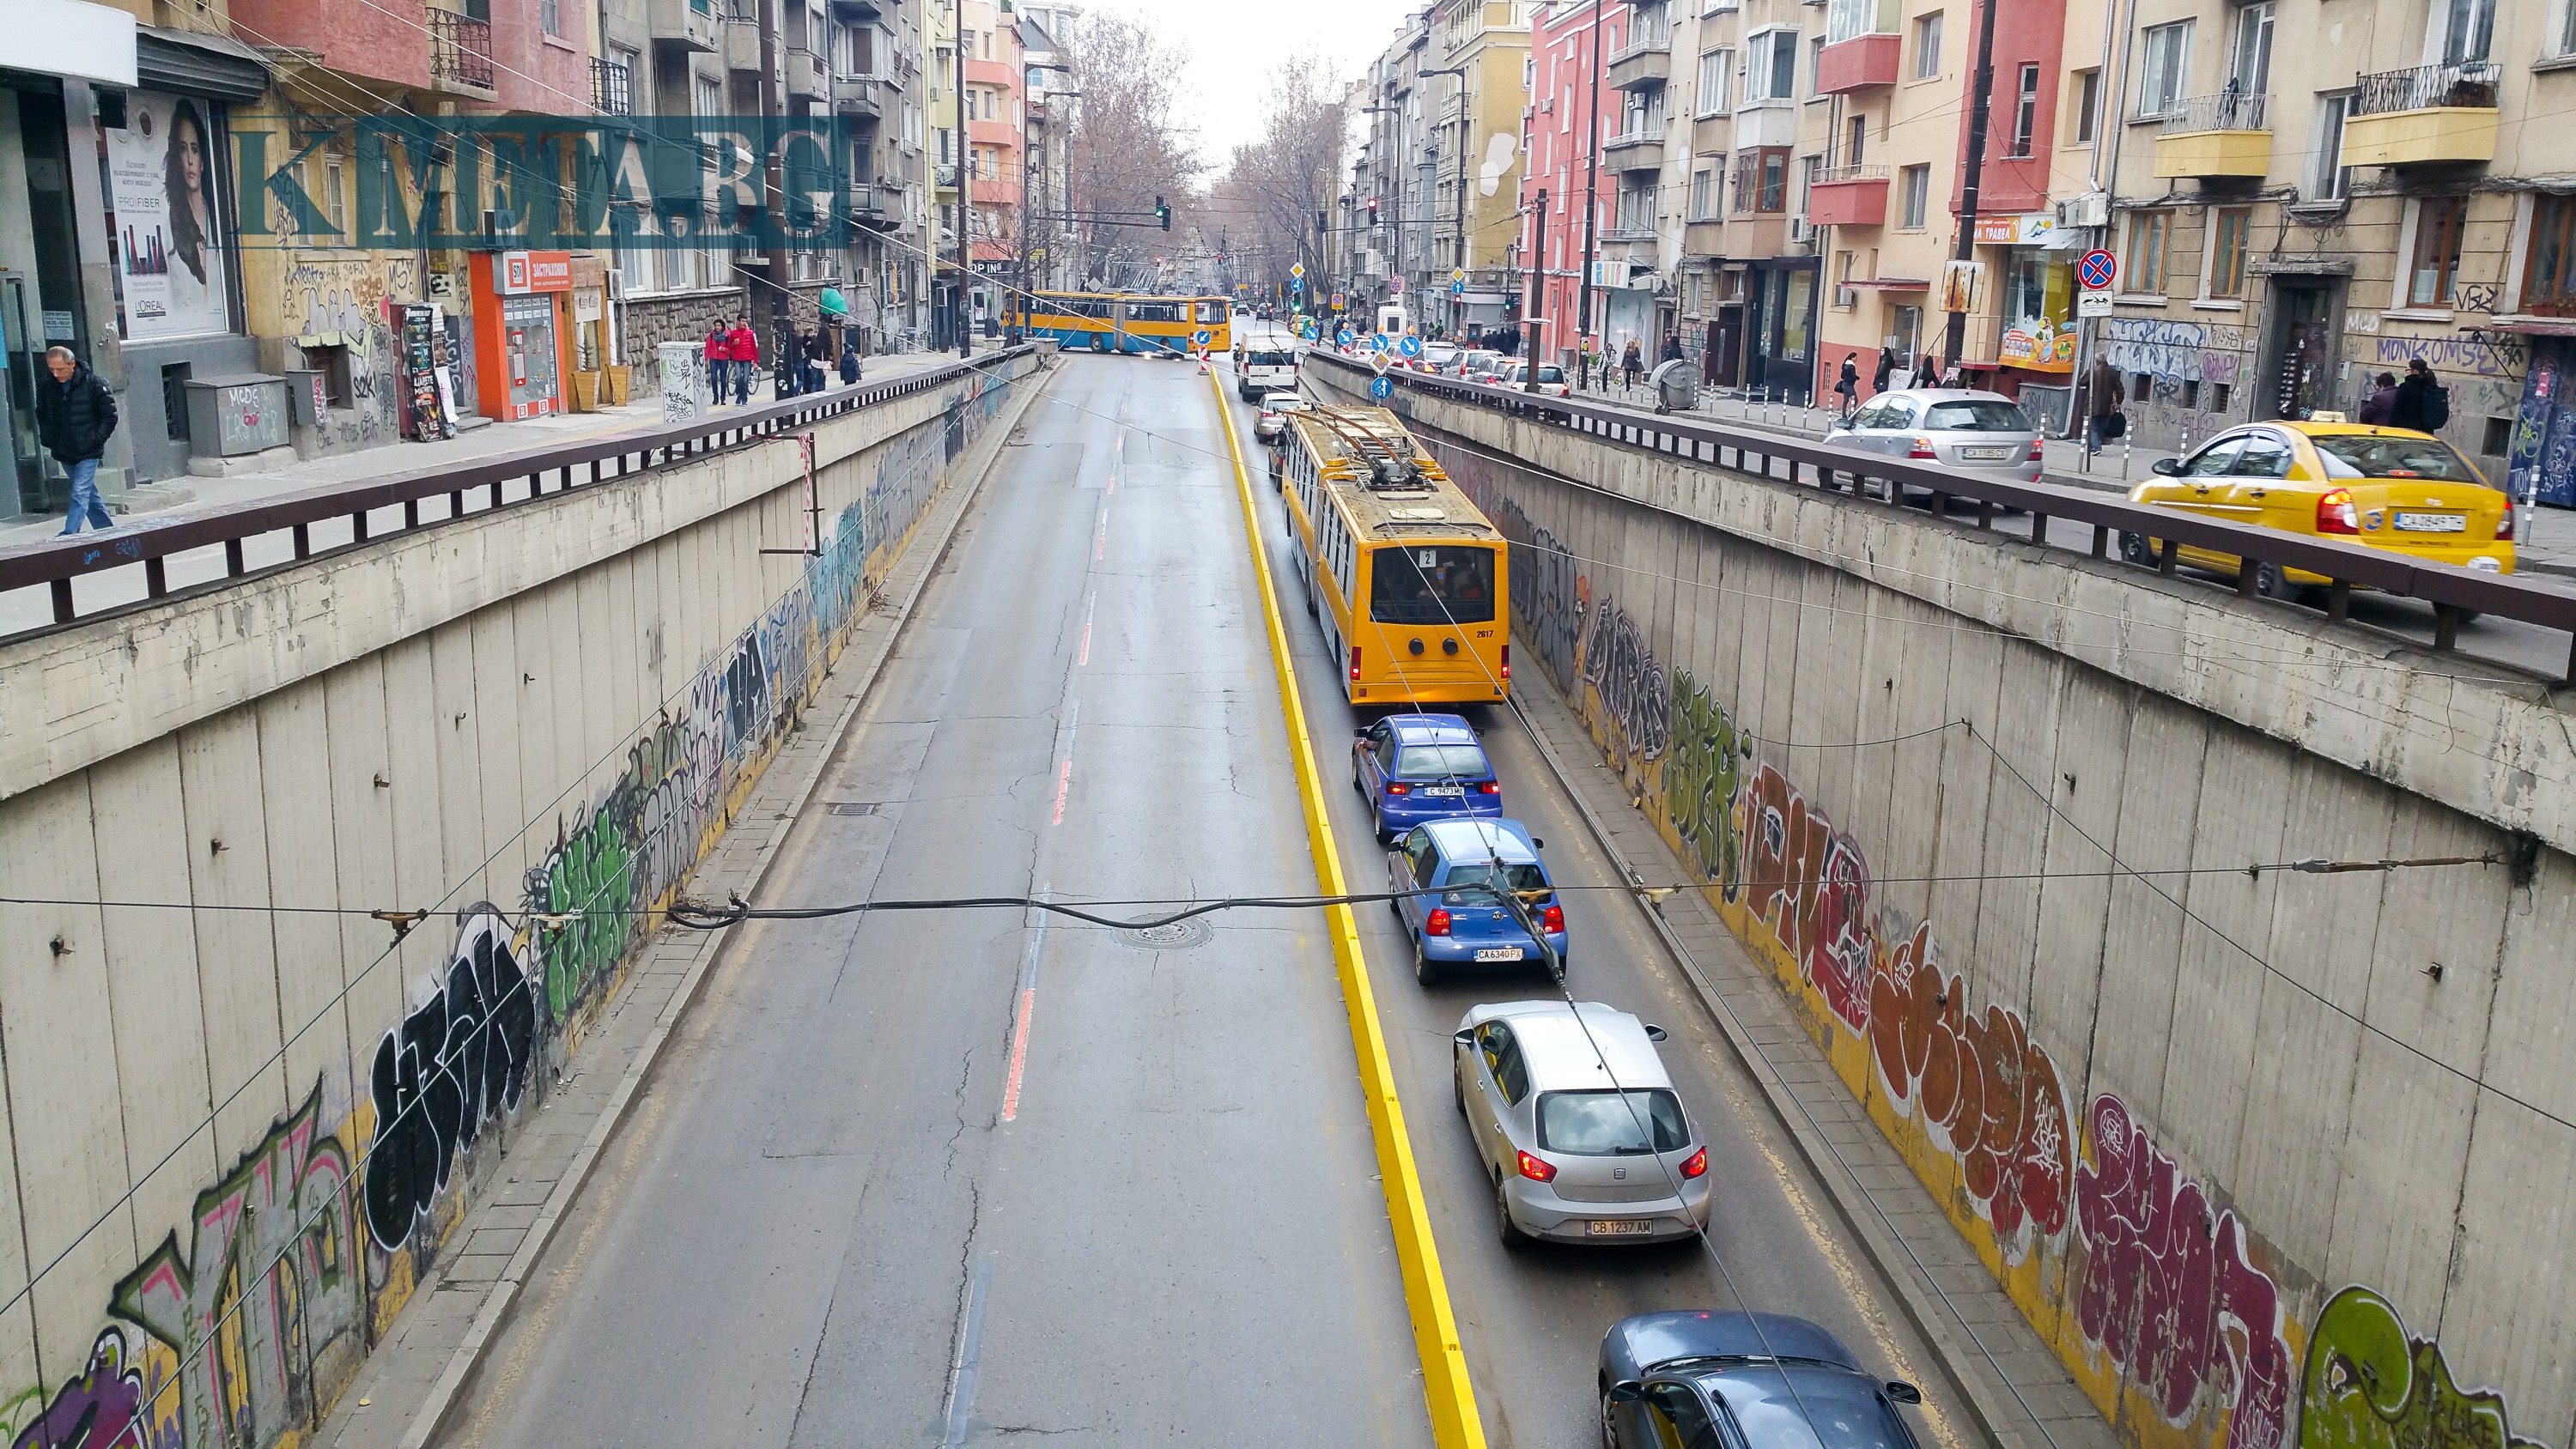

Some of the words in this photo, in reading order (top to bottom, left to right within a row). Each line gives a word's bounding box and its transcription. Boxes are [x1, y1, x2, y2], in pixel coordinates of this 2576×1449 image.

[137, 197, 160, 207] FIBER
[1425, 554, 1431, 565] 2
[1476, 629, 1494, 639] 2617
[1490, 950, 1510, 959] 6340
[1510, 949, 1521, 958] PX
[1593, 1222, 1607, 1234] CB
[1610, 1222, 1635, 1234] 1237
[1637, 1222, 1650, 1233] AM
